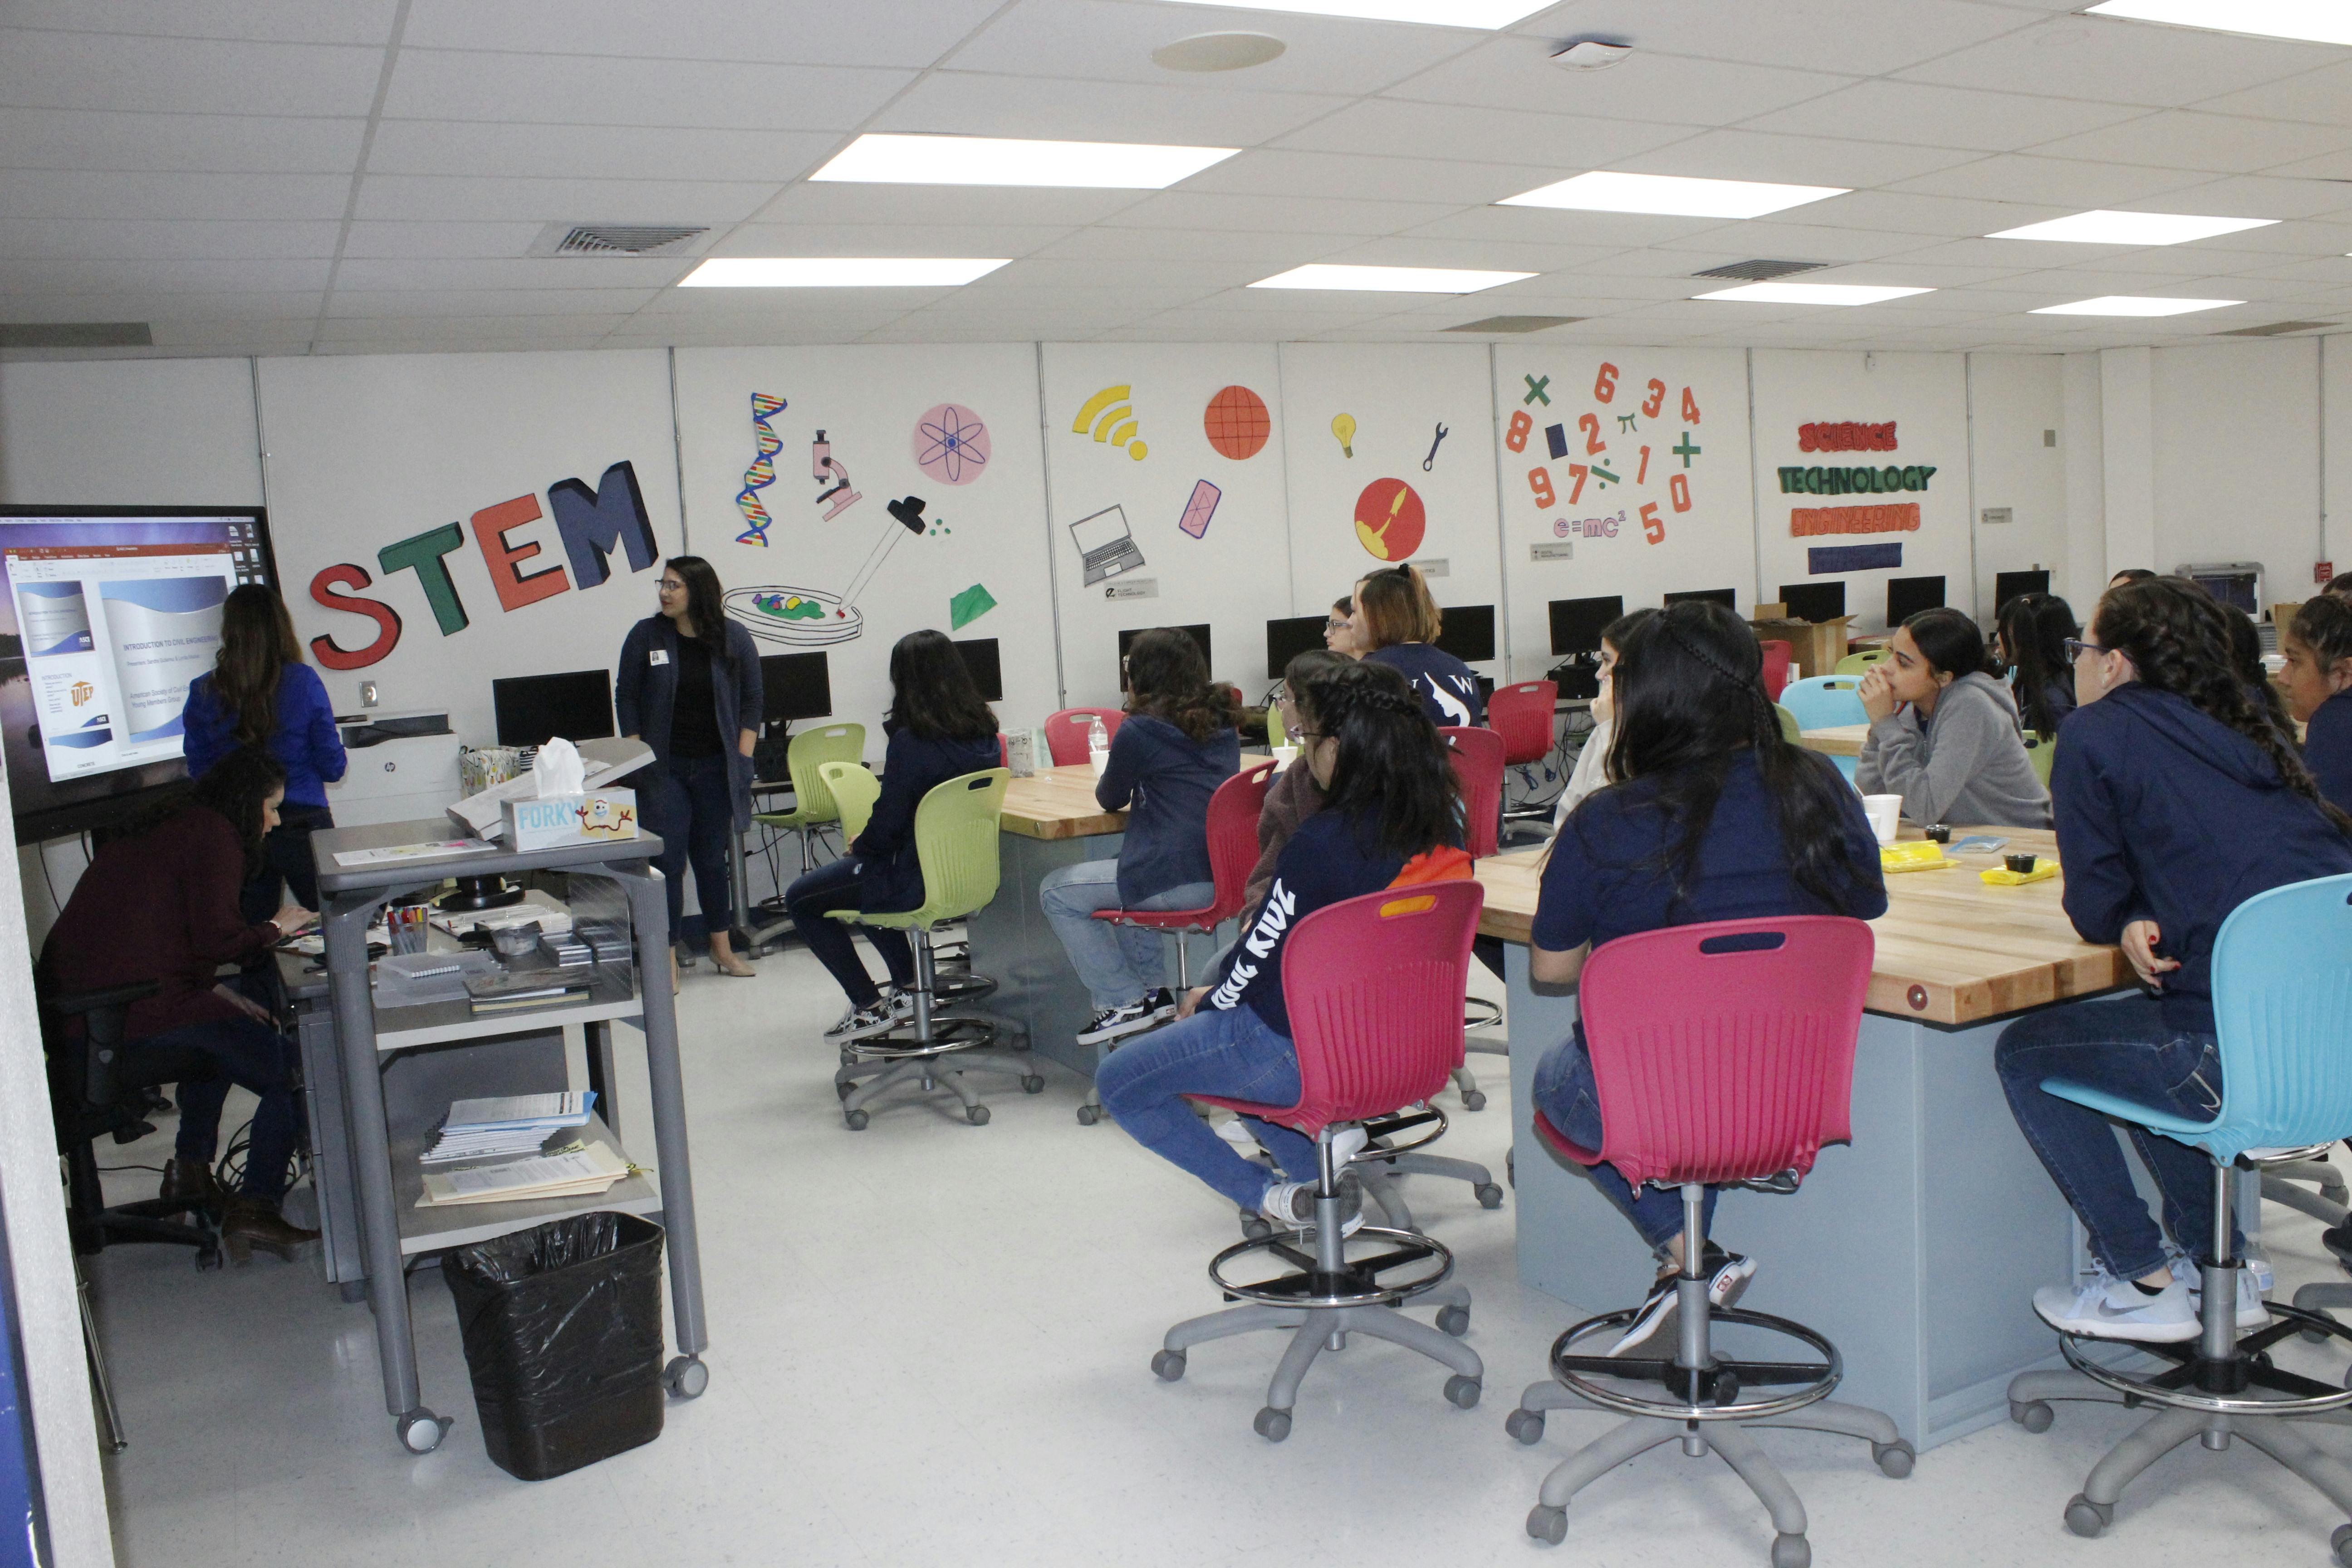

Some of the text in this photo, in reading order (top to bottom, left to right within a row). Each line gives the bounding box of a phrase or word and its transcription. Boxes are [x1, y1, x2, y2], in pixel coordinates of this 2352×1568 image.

[1594, 362, 1619, 404] 6
[1642, 378, 1666, 418] 3
[1682, 387, 1700, 425] 4
[1505, 410, 1533, 453] 8
[1579, 413, 1607, 456] 2
[1798, 421, 1897, 452] SCIENCE
[1528, 466, 1556, 509] 9
[1568, 463, 1588, 505] 7
[1778, 466, 1937, 495] TECHNOLOGY
[1639, 501, 1665, 545] 5
[1793, 504, 1920, 536] ENGINEERING
[310, 460, 659, 670] STEM
[123, 641, 163, 651] INTRODUCTION
[71, 681, 93, 706] UTEP
[517, 801, 579, 829] FORKY
[1245, 878, 1296, 959] KIDZ
